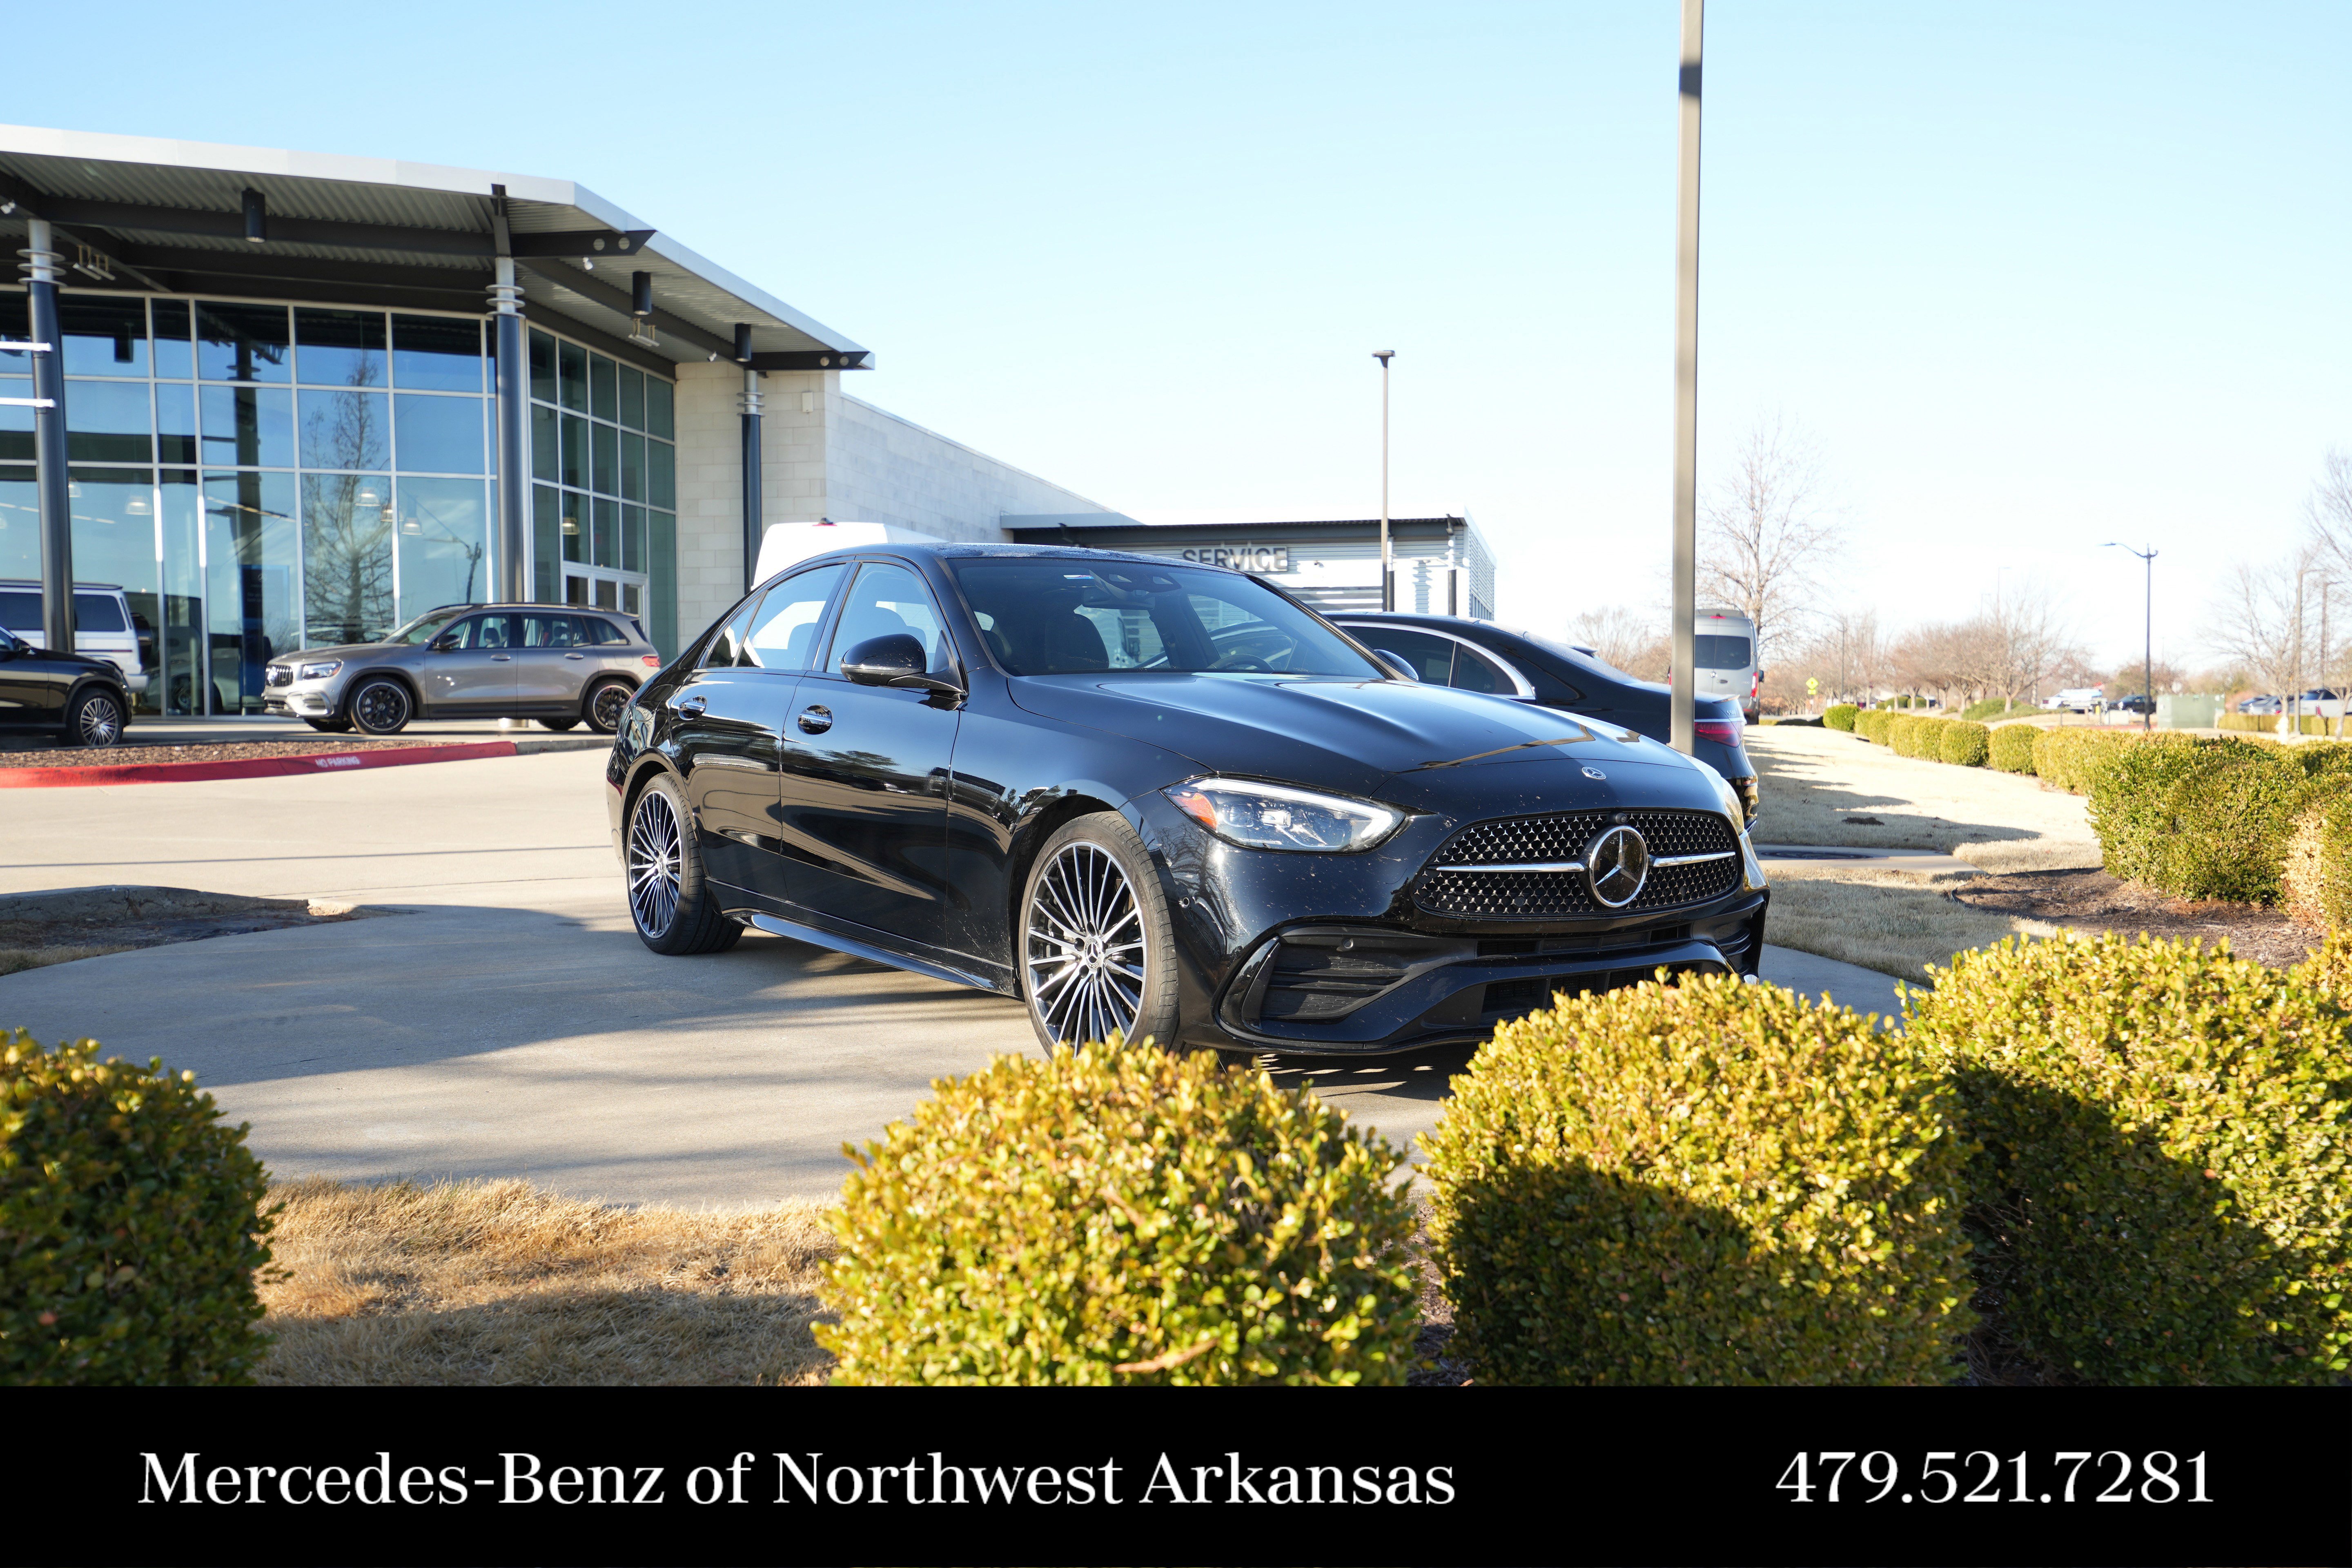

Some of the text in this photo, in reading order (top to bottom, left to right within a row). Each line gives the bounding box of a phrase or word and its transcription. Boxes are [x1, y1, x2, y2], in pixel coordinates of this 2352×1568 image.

[1183, 548, 1287, 570] SERVICE
[315, 756, 361, 768] NO PARKING
[1036, 831, 1067, 869] GOODYEAR
